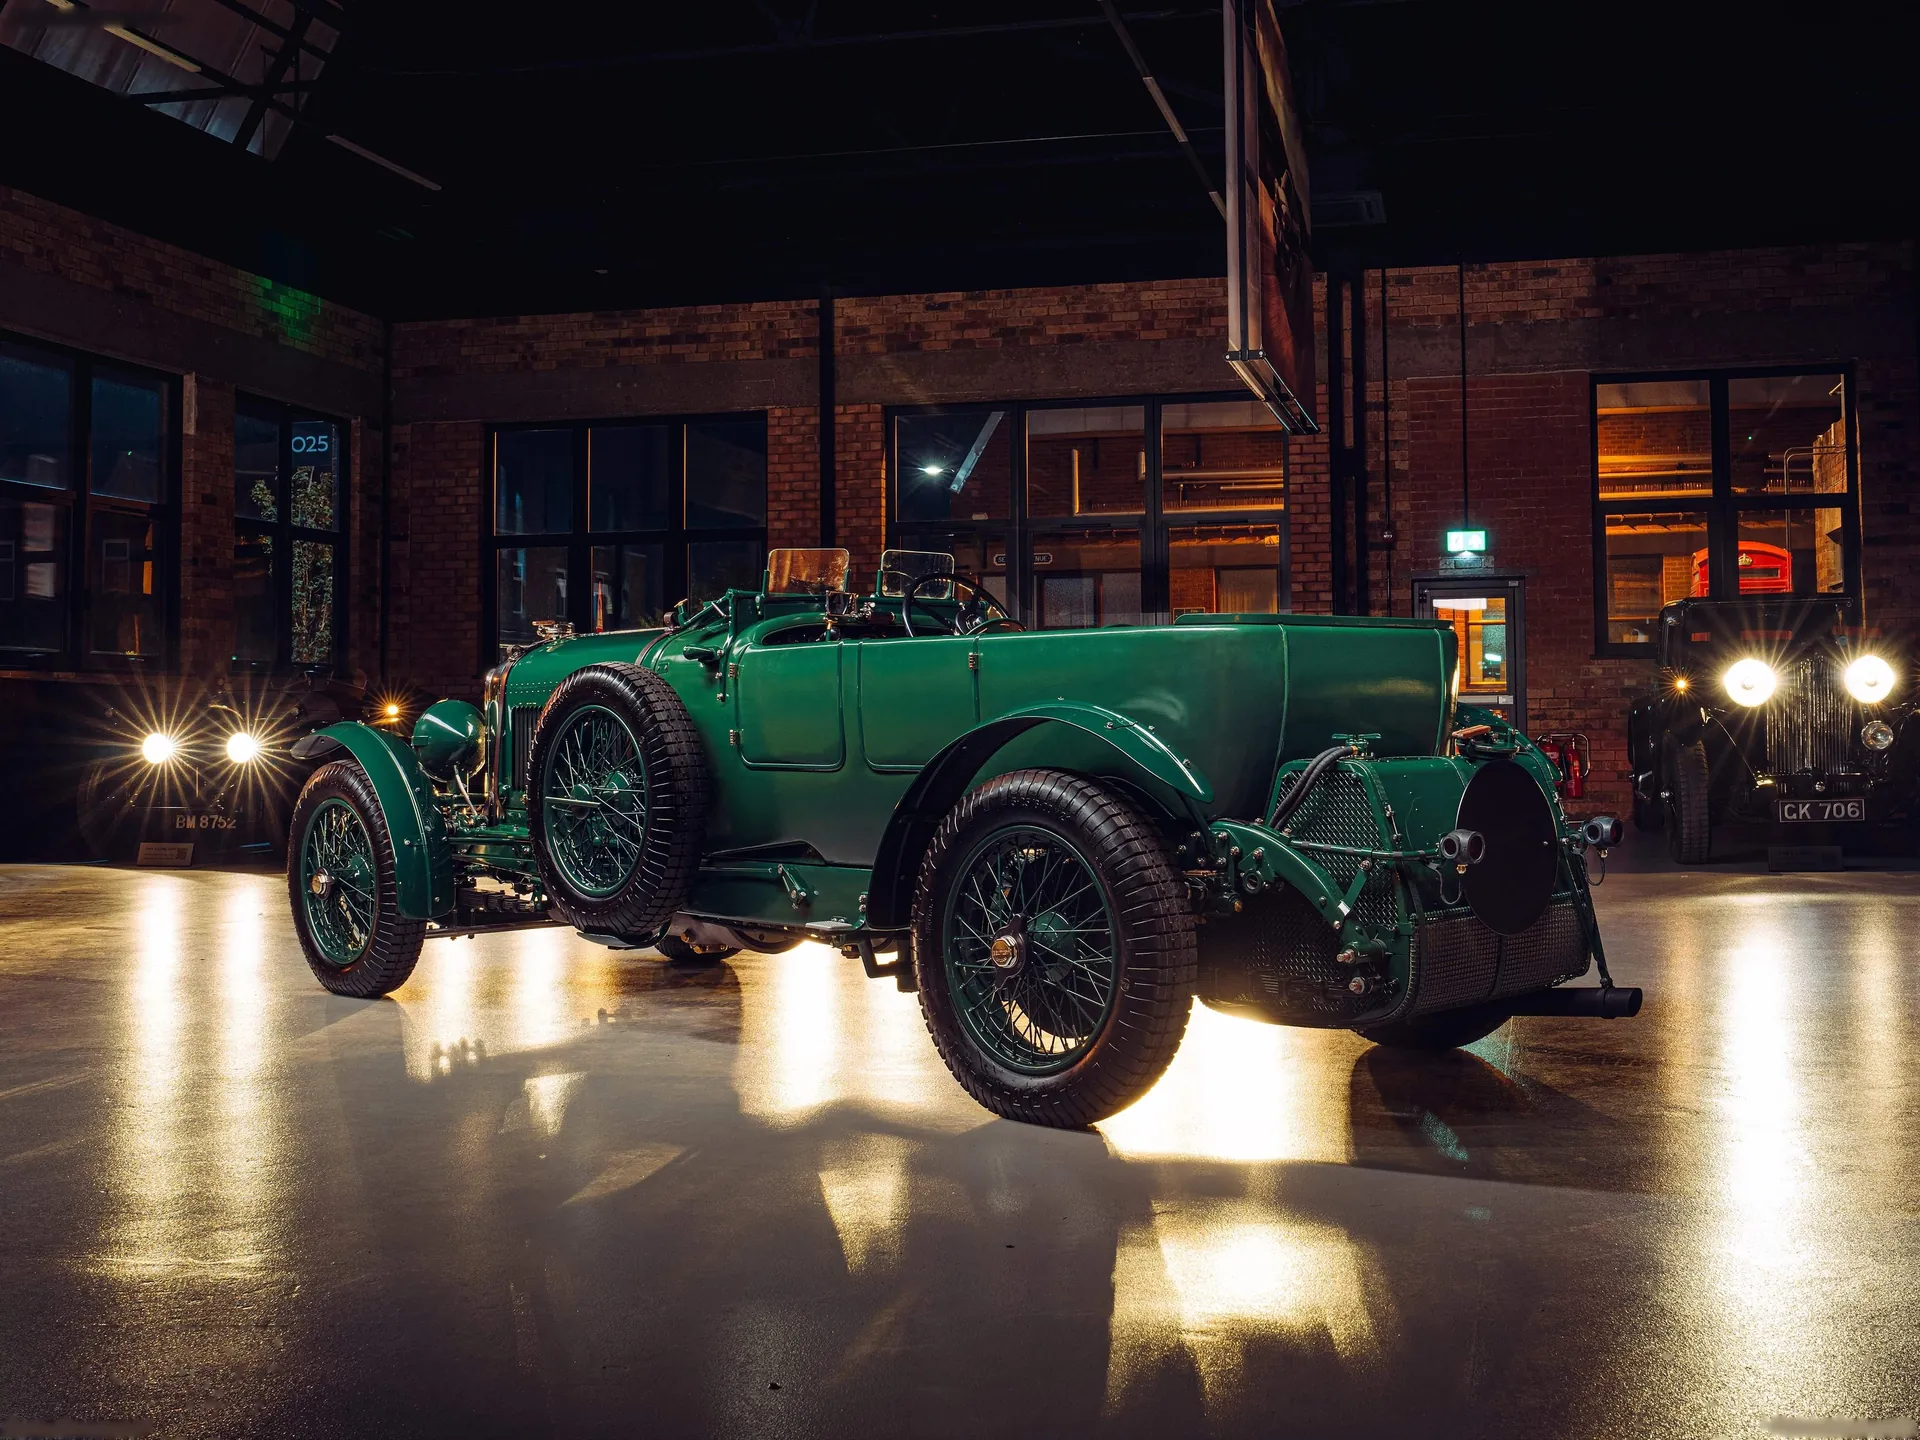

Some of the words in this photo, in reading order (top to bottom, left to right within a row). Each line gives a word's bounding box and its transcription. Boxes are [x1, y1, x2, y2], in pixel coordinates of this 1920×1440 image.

[1783, 802, 1811, 820] GK
[1819, 802, 1860, 820] 706
[175, 814, 196, 829] BM
[199, 814, 236, 829] 8752
